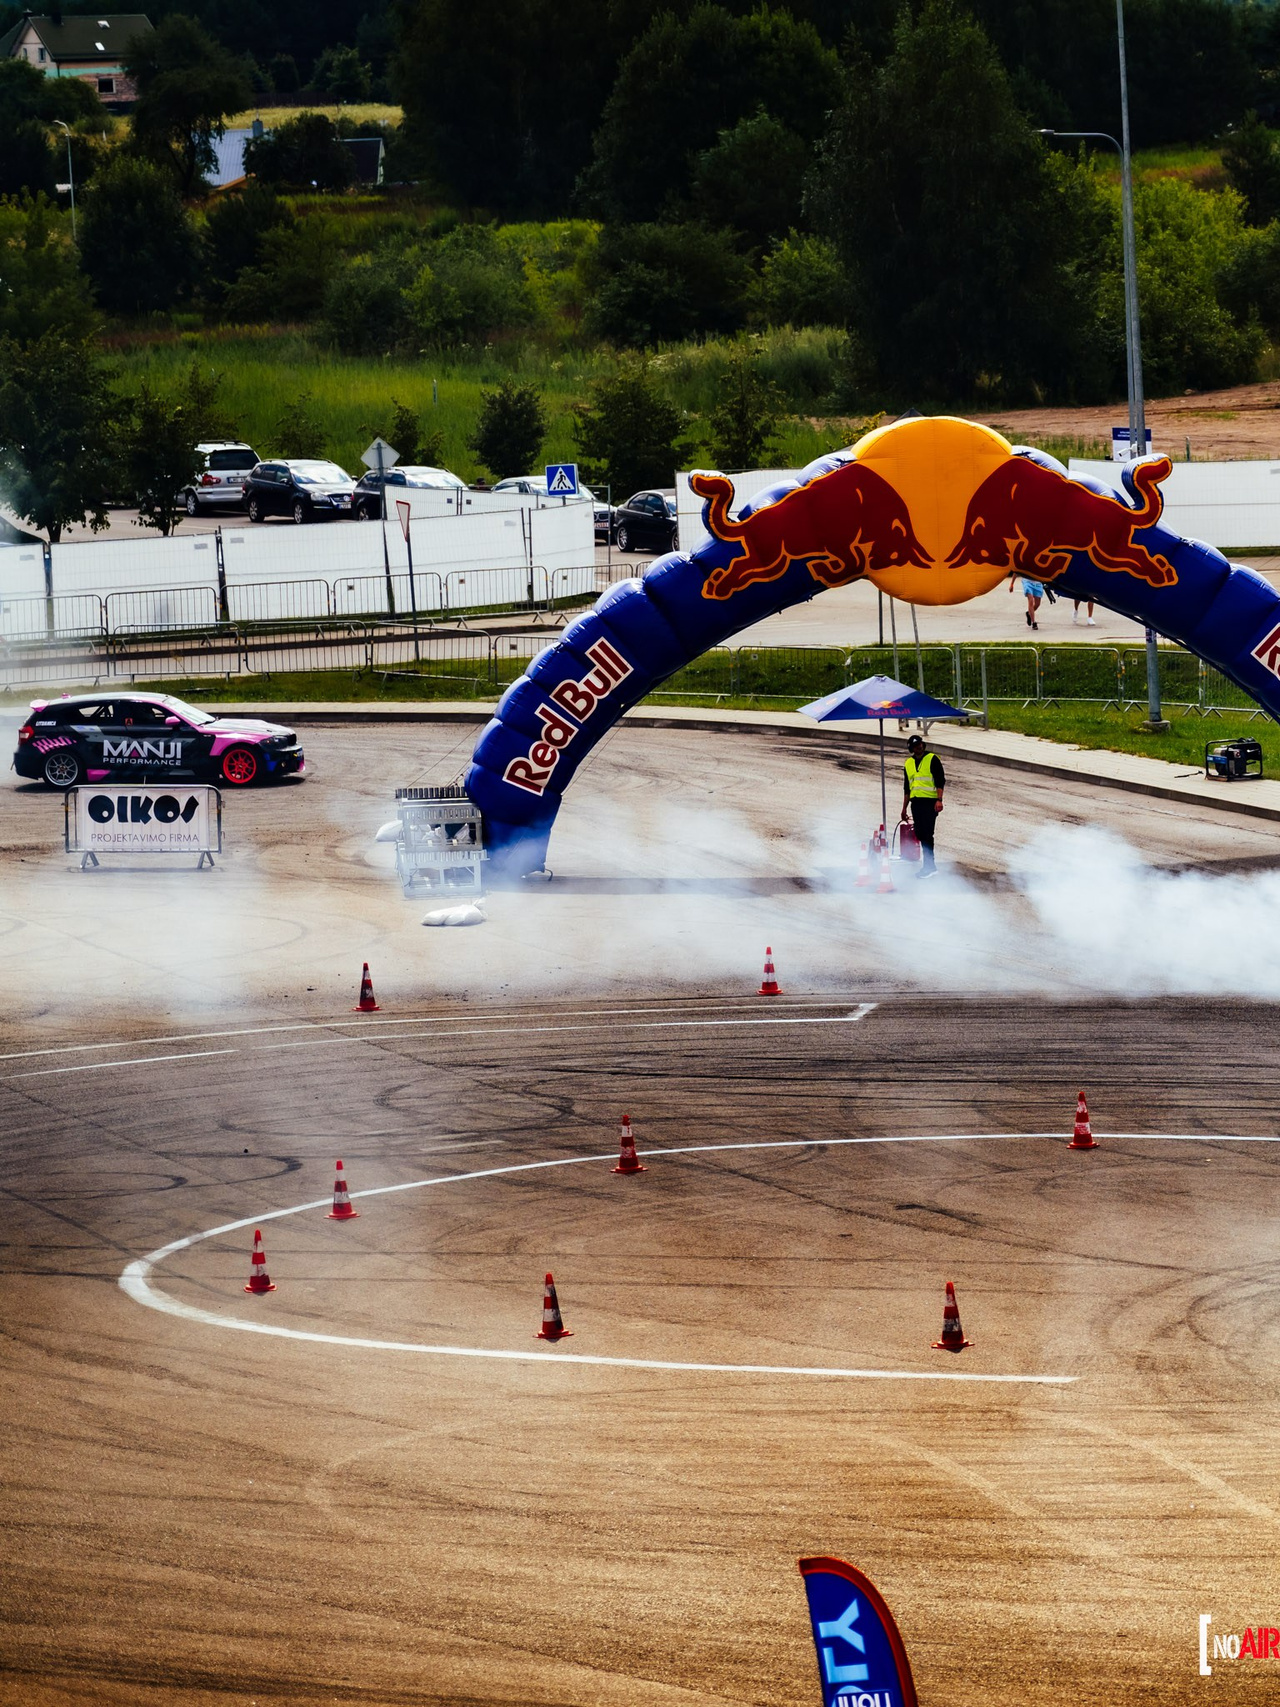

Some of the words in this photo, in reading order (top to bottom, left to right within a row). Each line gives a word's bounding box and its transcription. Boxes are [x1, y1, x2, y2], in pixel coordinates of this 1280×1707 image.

[502, 703, 579, 796] Red
[549, 636, 634, 723] Bull
[103, 740, 181, 759] MANJI
[103, 757, 181, 766] PERFORMANCE
[88, 795, 199, 825] OIKOS
[91, 833, 166, 843] PROJEKTAVIMO
[169, 833, 198, 842] FIRMA
